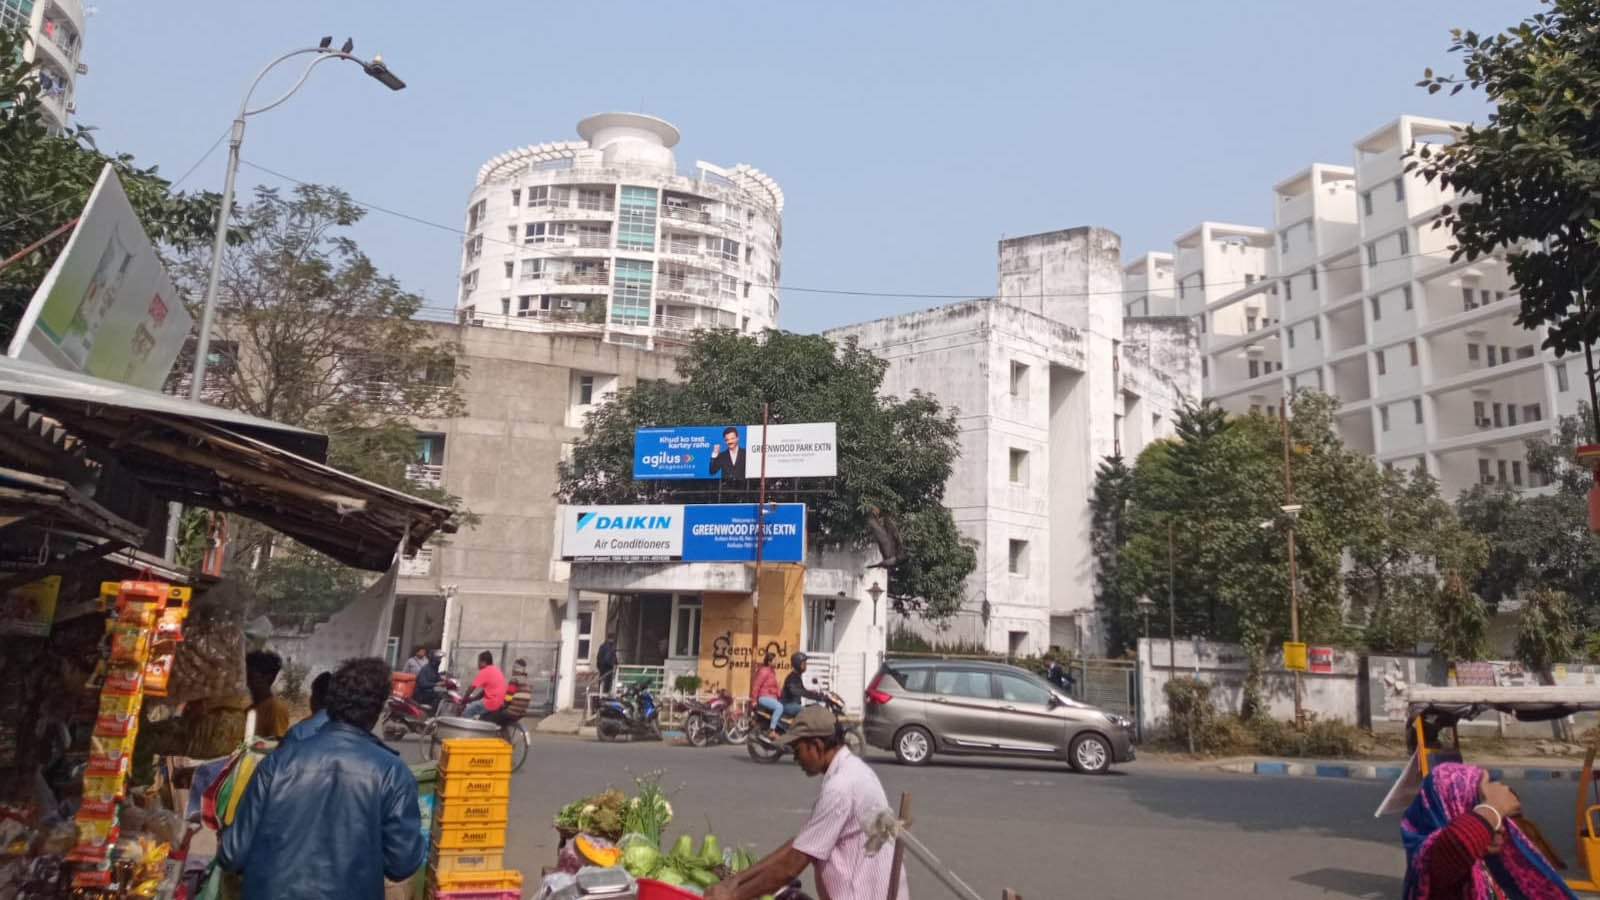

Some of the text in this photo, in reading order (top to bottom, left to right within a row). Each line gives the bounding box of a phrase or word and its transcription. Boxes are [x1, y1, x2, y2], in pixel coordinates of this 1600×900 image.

[796, 443, 813, 452] PARK
[814, 443, 831, 452] EXTN
[642, 451, 681, 467] agilus
[595, 515, 672, 530] DAIKIN
[692, 524, 748, 535] GREENWOOD
[773, 524, 796, 535] EXTN
[594, 538, 671, 549] Air Conditioners
